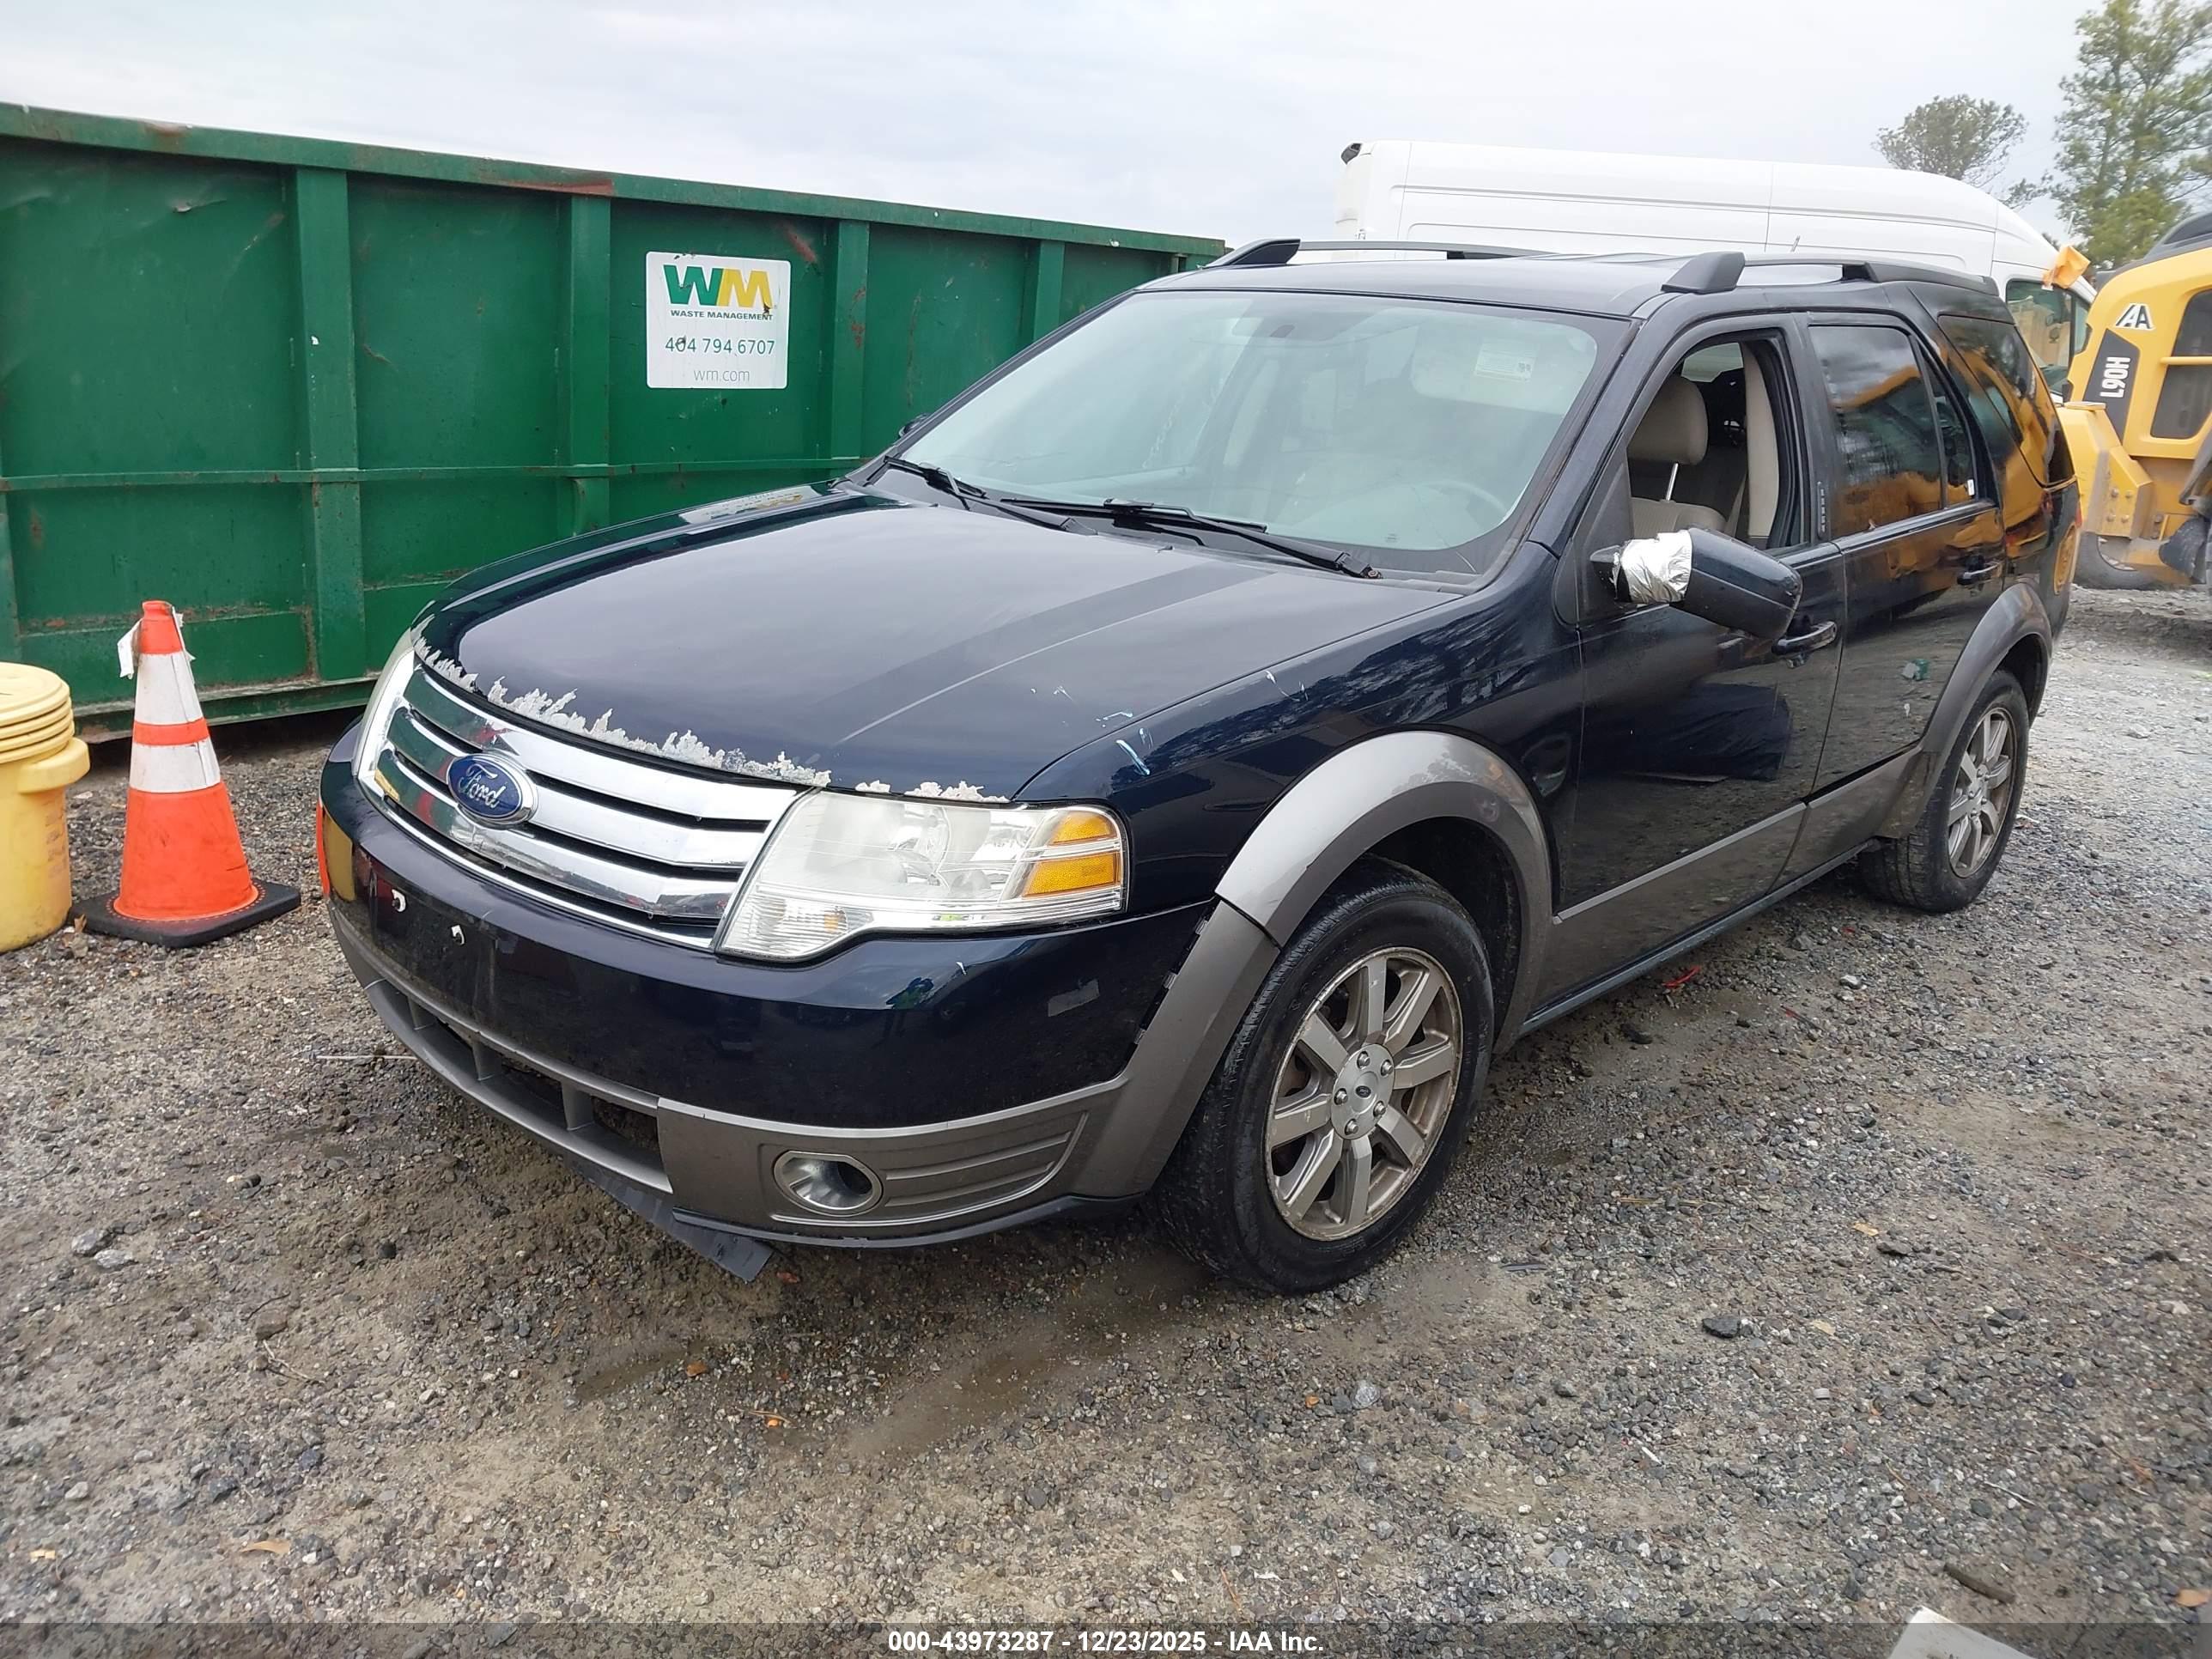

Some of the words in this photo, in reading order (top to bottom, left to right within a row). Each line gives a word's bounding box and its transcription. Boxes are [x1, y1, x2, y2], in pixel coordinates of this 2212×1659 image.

[663, 264, 773, 307] WM
[707, 312, 774, 320] MANAGEMENT
[665, 337, 696, 352] 404
[702, 338, 732, 354] 794
[738, 340, 775, 355] 6707
[693, 370, 750, 382] wm.com
[2100, 356, 2131, 398] L90H
[459, 763, 507, 809] Ford
